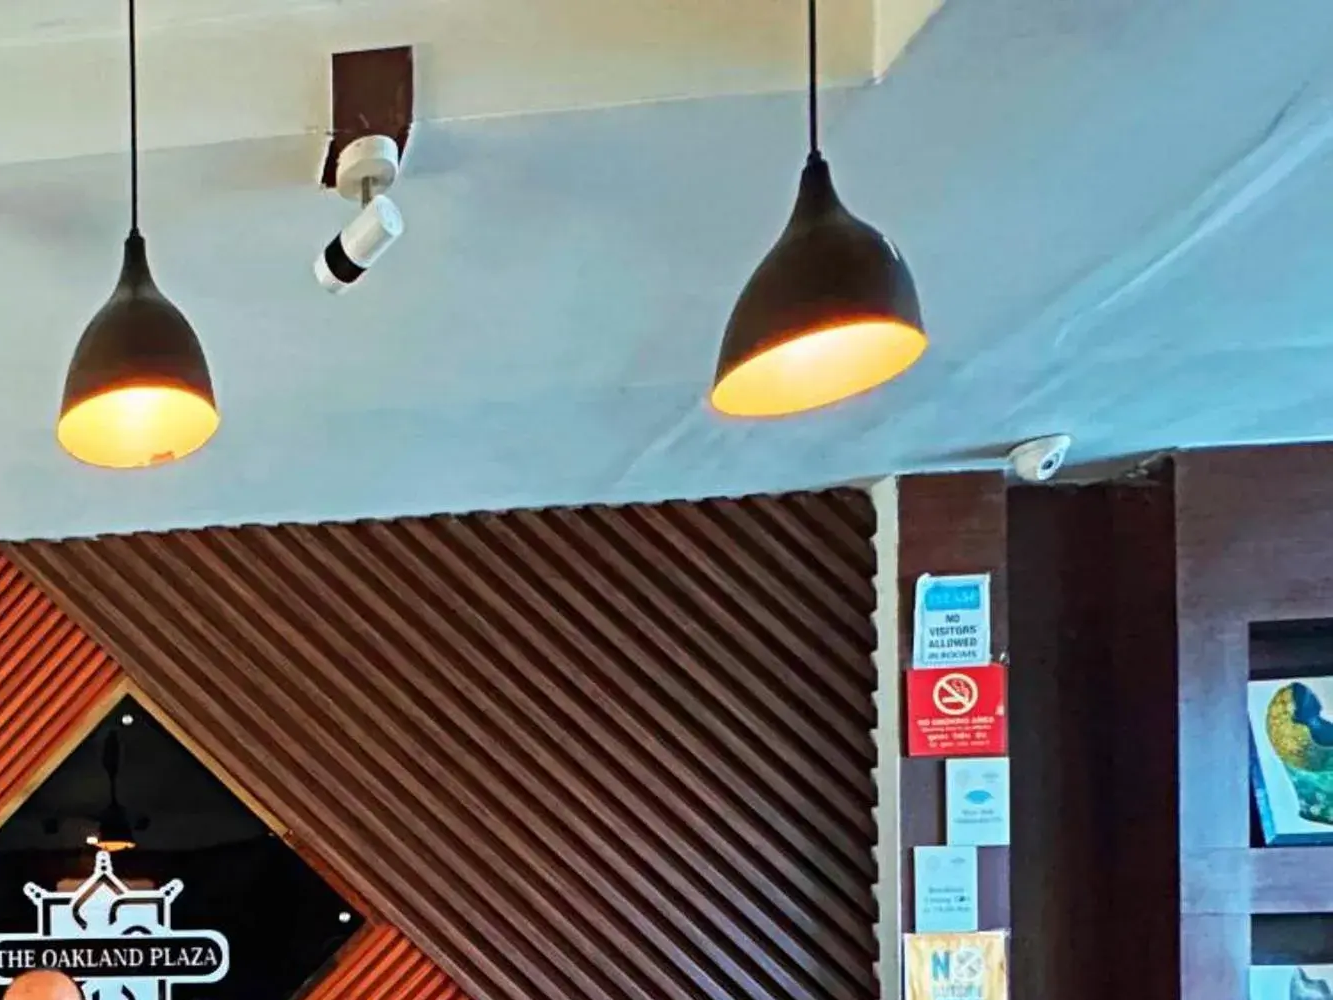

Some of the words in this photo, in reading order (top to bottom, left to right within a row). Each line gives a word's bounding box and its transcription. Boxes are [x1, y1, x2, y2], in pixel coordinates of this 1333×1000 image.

[945, 613, 961, 623] NO
[928, 625, 978, 637] VISITORS
[928, 637, 978, 648] ALLOWED
[41, 948, 144, 968] OAKLAND
[150, 946, 218, 967] PLAZA
